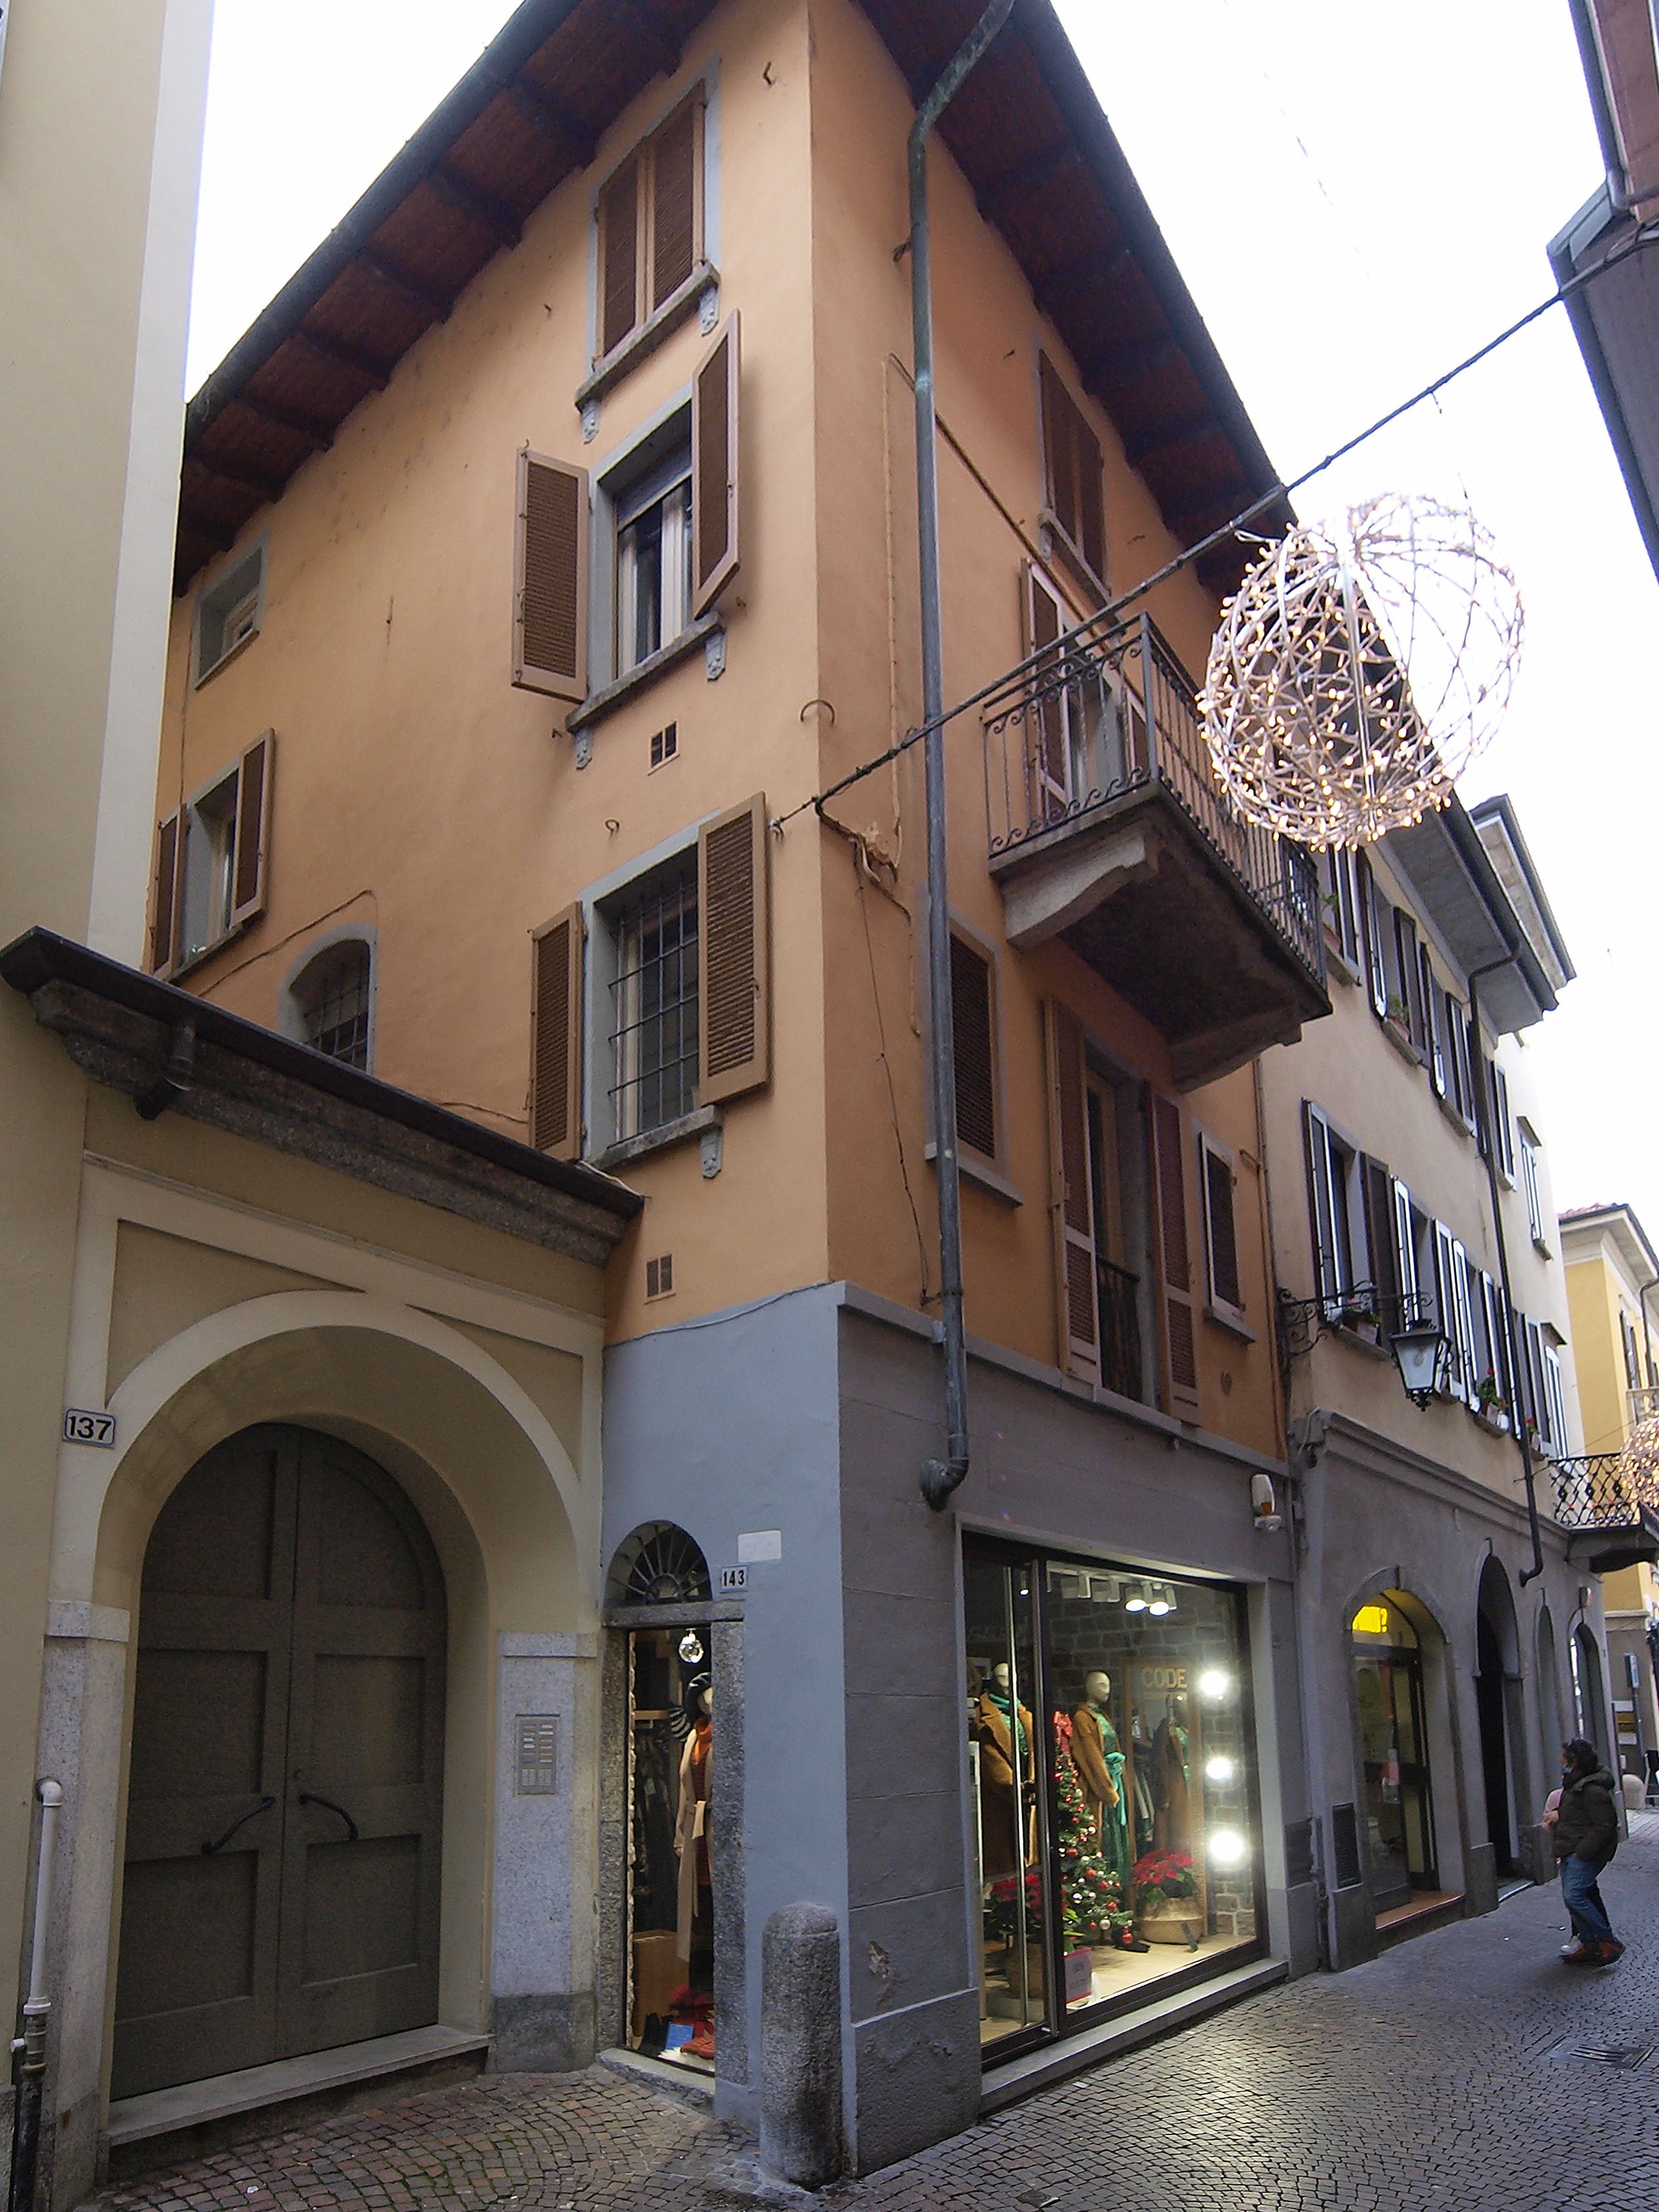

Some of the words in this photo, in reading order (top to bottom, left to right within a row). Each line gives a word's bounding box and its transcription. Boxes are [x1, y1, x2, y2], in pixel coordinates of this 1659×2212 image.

[69, 1415, 112, 1441] 137
[723, 1569, 745, 1587] 143
[1141, 1667, 1188, 1689] CODE
